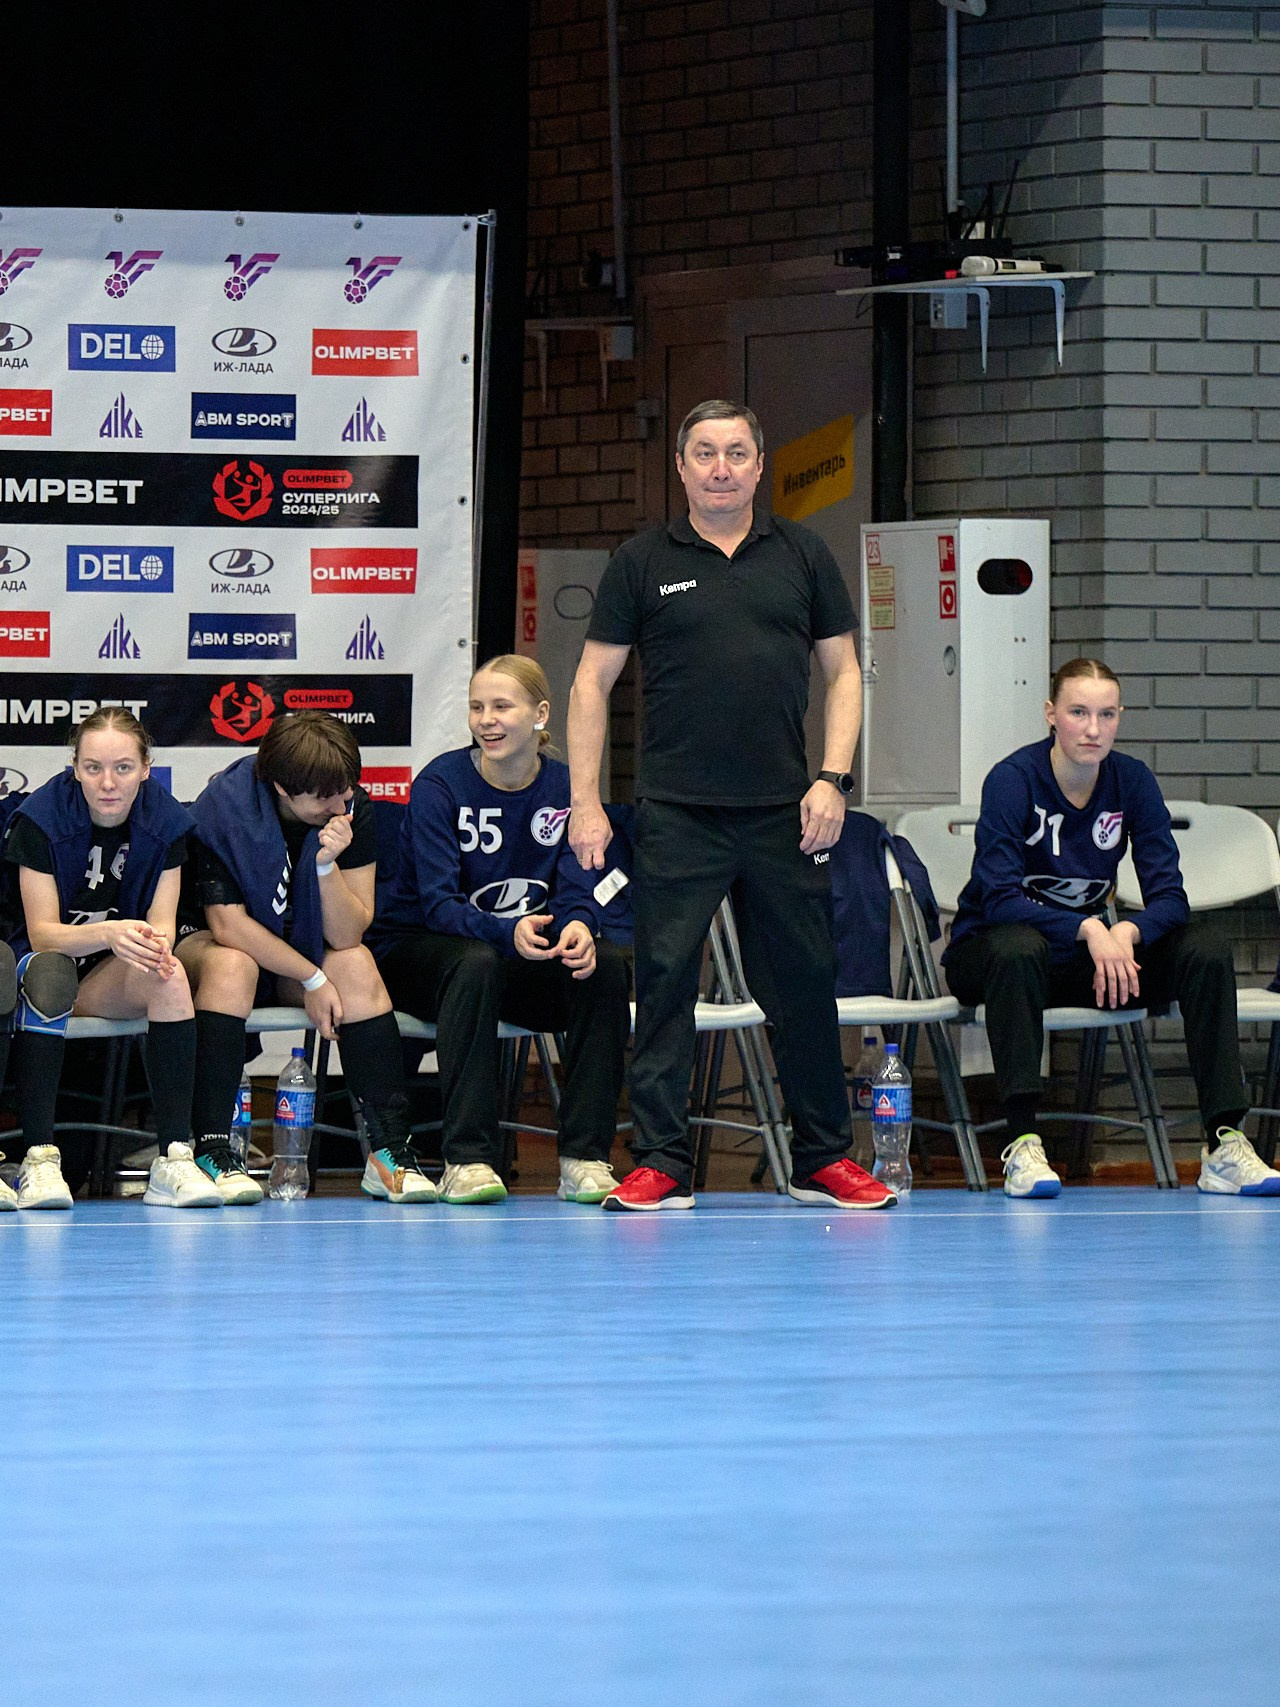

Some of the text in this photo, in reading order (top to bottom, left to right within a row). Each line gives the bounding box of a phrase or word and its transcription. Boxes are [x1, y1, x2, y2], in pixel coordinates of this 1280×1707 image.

[315, 346, 415, 359] OLIMPBET
[214, 362, 273, 374] ИЖ-ЛАДА
[236, 413, 293, 427] SPORT
[288, 475, 346, 483] OLIMPBET
[783, 453, 846, 496] Инвентарь
[283, 492, 380, 503] СУПЕРЛИГА
[282, 505, 339, 515] 2024/25
[313, 567, 414, 580] OLIMPBET
[211, 583, 270, 595] ИЖ-ЛАДА
[659, 578, 697, 596] Kempa
[233, 632, 292, 646] SPORT
[290, 695, 348, 703] OLIMPBET
[457, 806, 503, 854] 55
